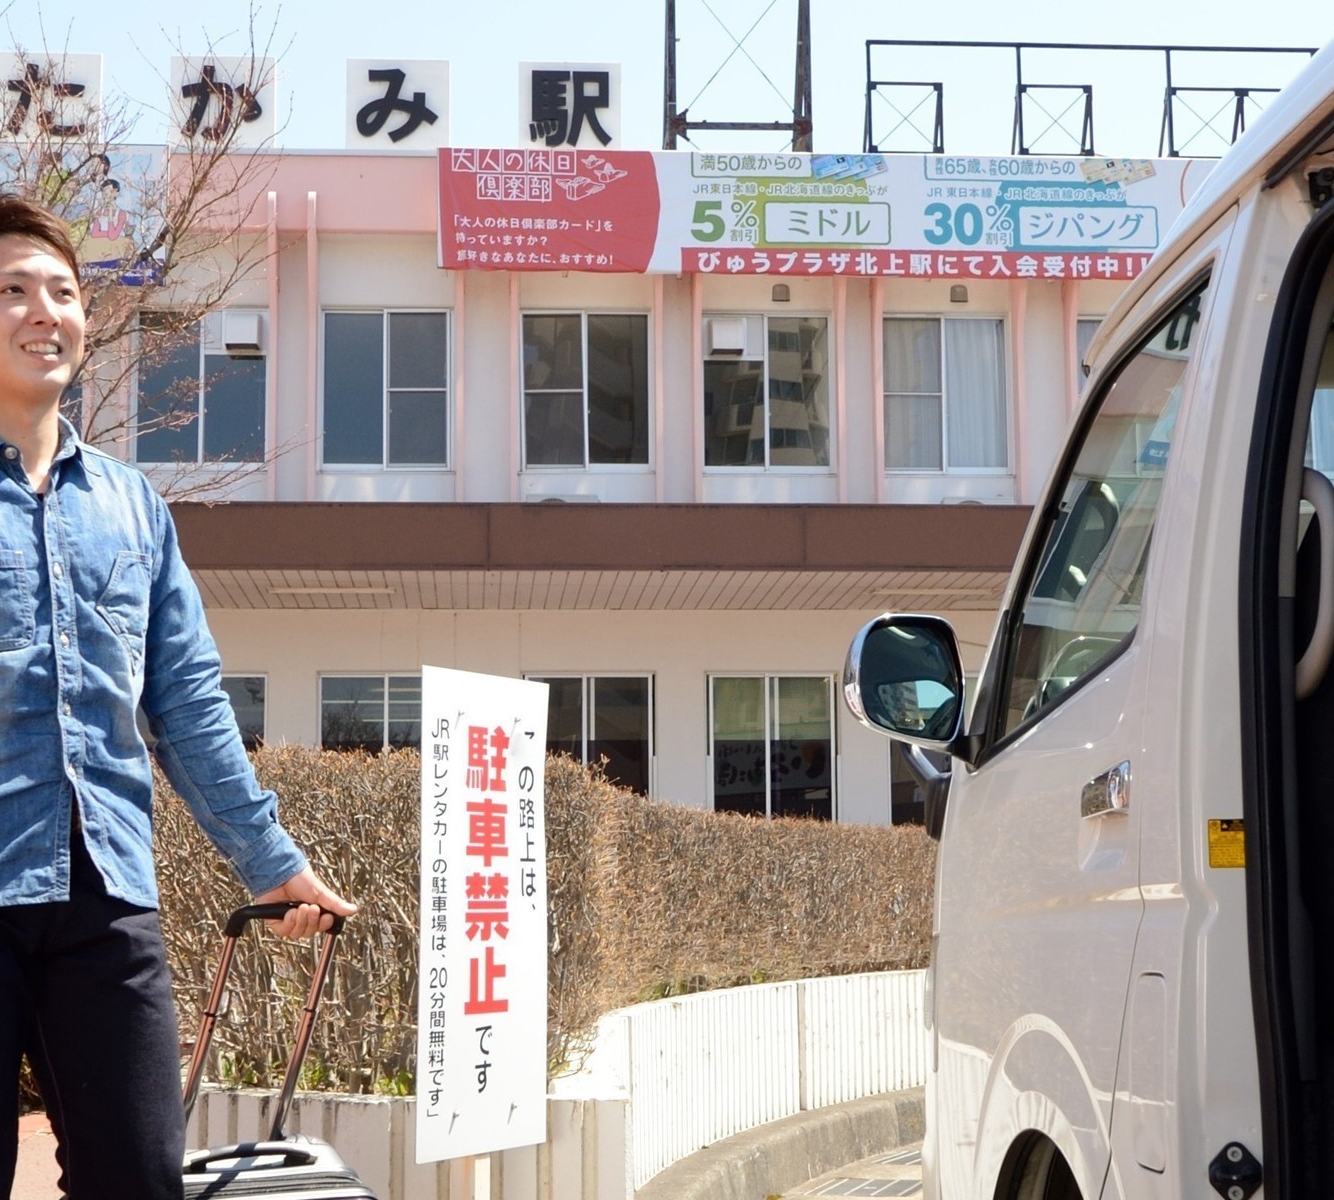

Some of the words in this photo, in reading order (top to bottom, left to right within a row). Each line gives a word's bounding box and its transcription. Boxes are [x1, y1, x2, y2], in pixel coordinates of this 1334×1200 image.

[452, 149, 572, 173] 大人の休日
[700, 154, 802, 172] 満50歳からの
[479, 175, 551, 203] 倶楽部
[730, 229, 757, 242] 割引
[788, 208, 872, 237] ミドル
[923, 202, 1013, 246] 30%
[1029, 212, 1145, 241] ジパング
[985, 232, 1013, 246] 割引
